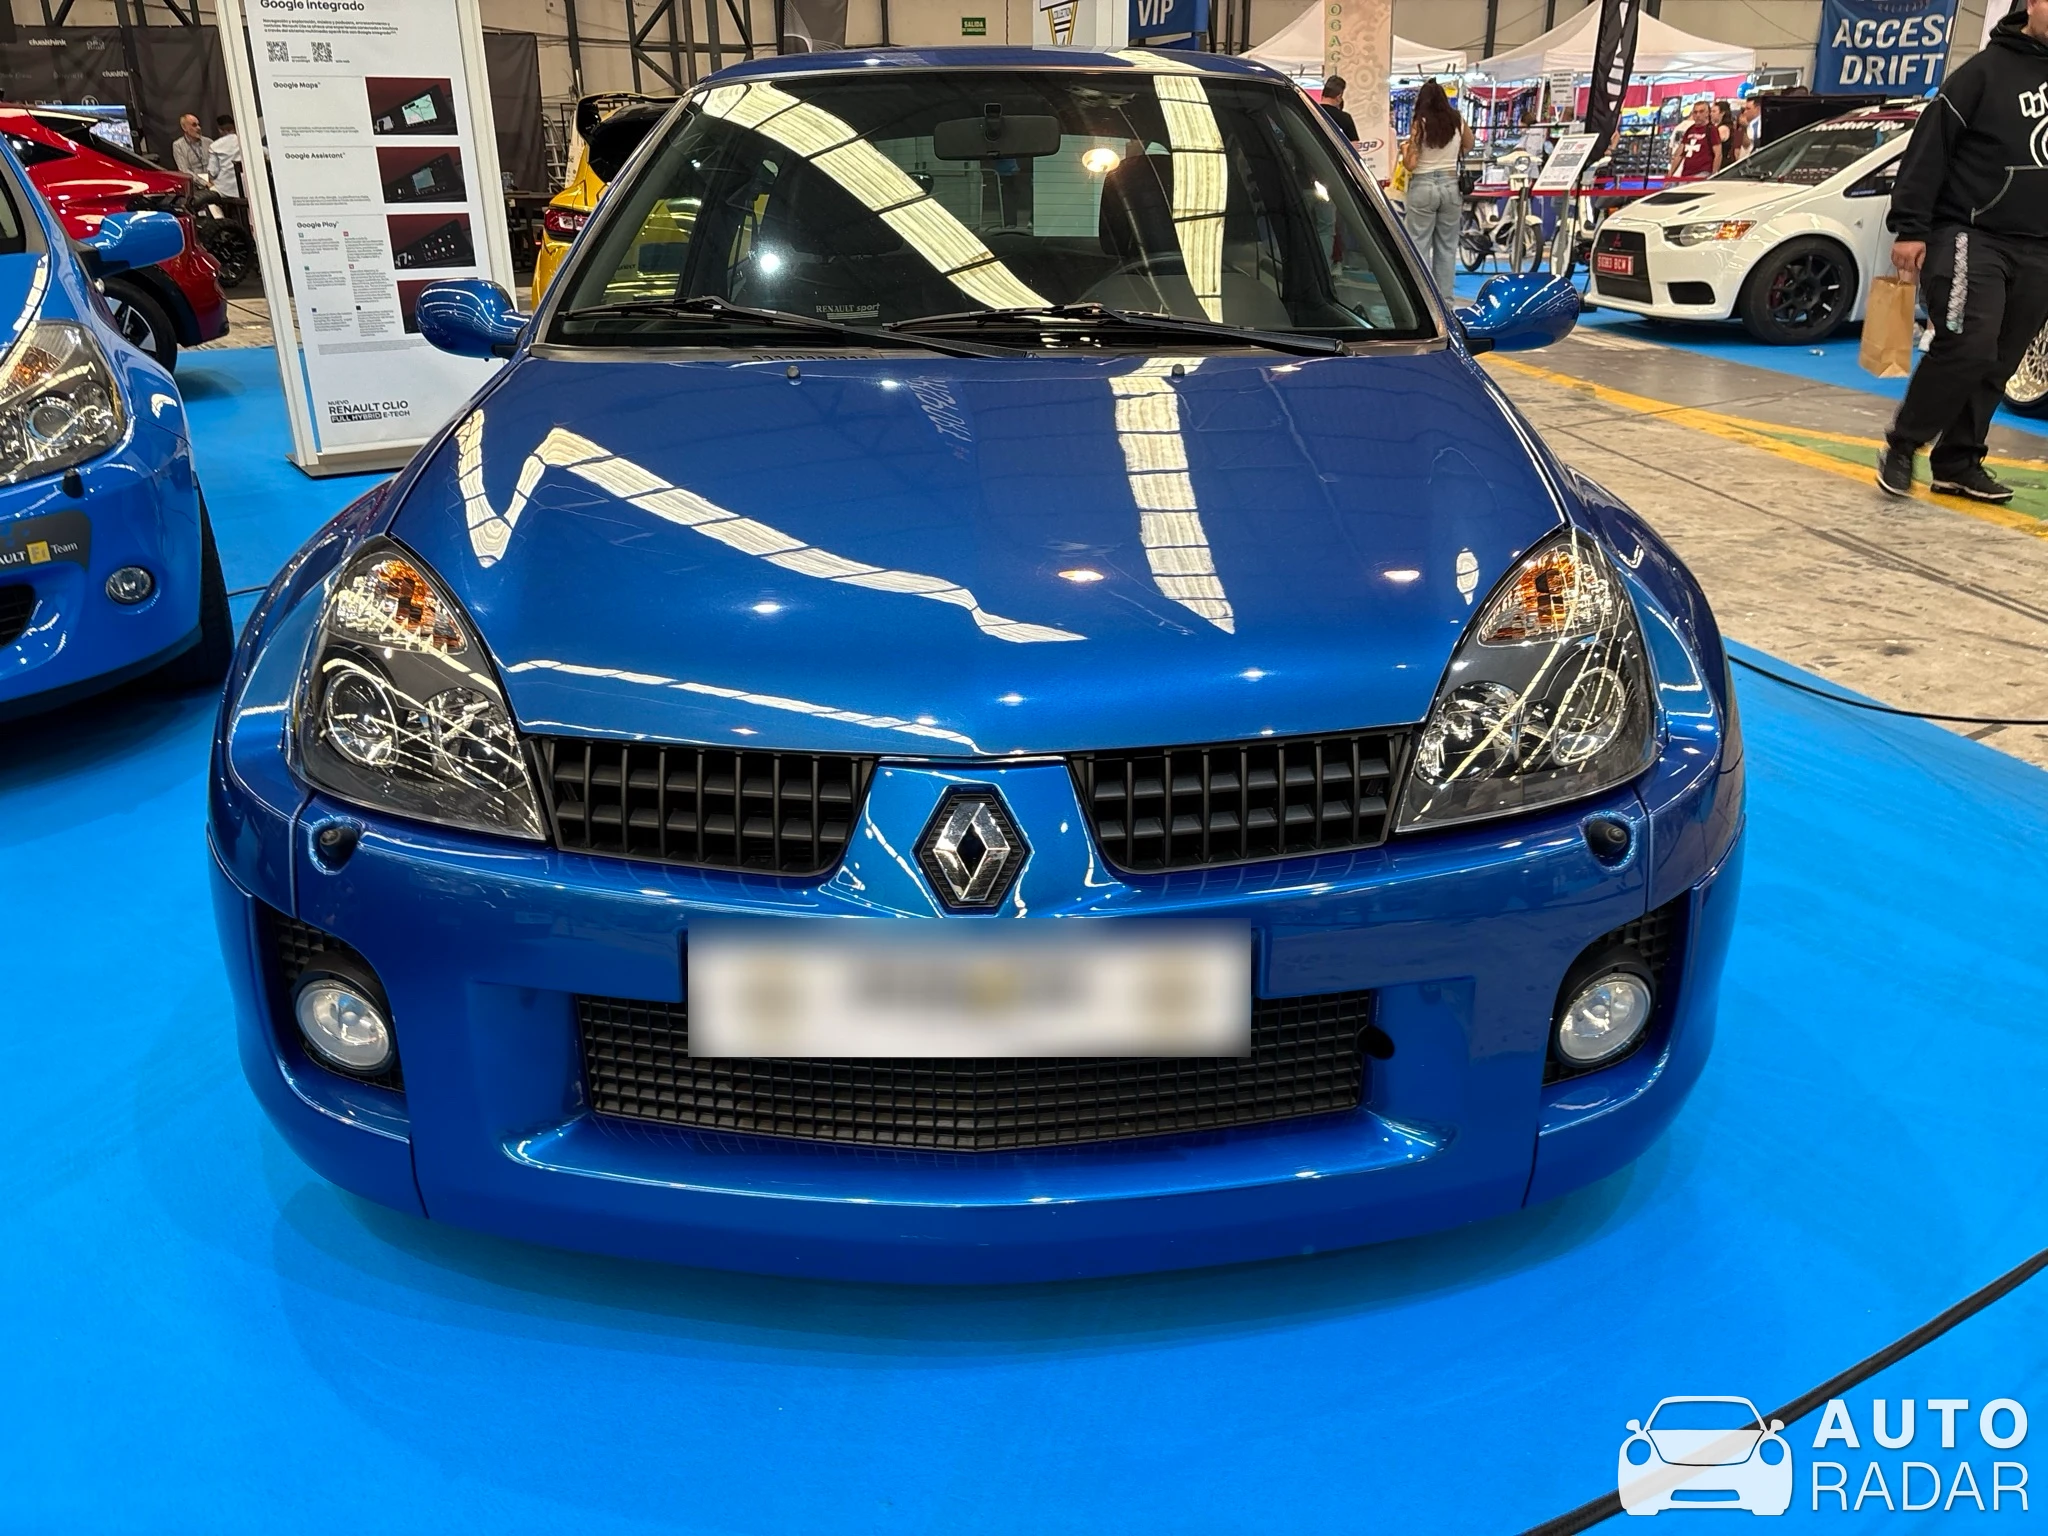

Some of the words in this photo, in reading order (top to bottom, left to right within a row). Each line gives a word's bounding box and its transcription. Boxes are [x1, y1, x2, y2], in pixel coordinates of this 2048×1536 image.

[260, 0, 304, 11] Google
[1138, 0, 1174, 27] VIP
[963, 20, 984, 28] SALIDA
[1839, 53, 1945, 86] DRIFT
[815, 305, 855, 313] RENAULT
[856, 303, 881, 313] sport
[328, 403, 381, 415] RENAULT
[382, 400, 409, 410] CLIO
[331, 414, 351, 422] FULL
[352, 412, 382, 421] HYBRID
[383, 410, 411, 418] E-TECH
[50, 542, 79, 555] Team
